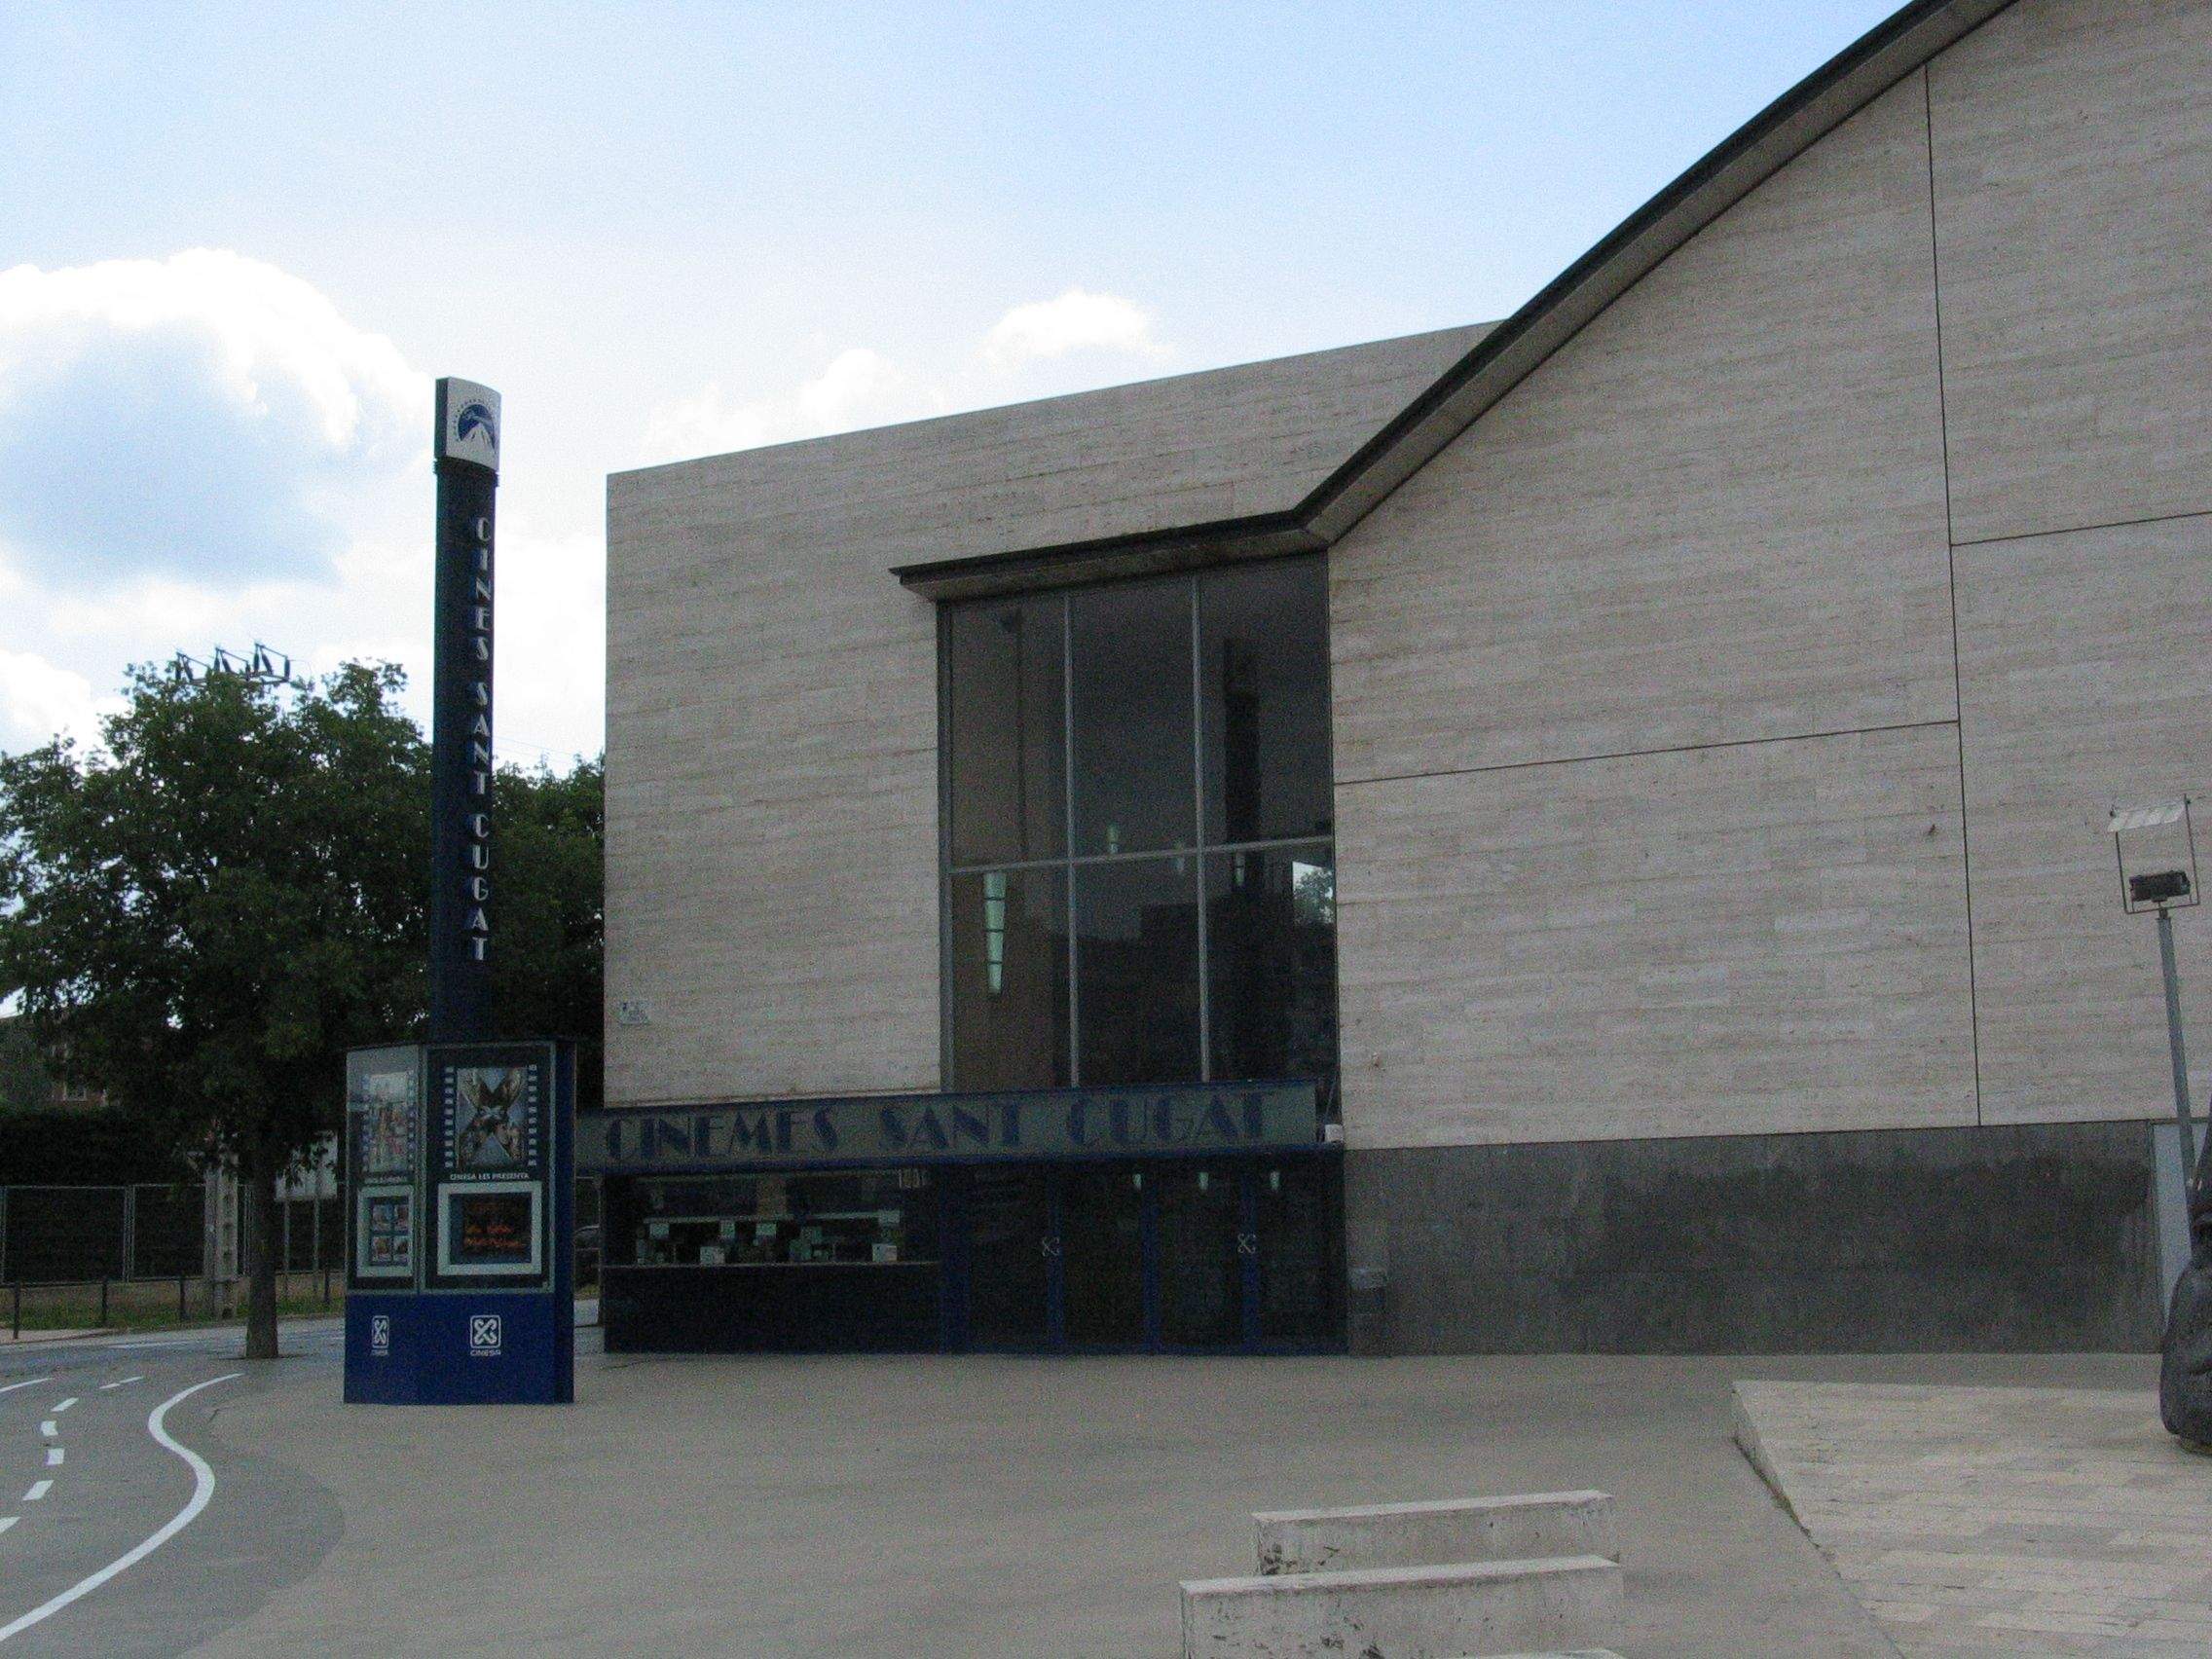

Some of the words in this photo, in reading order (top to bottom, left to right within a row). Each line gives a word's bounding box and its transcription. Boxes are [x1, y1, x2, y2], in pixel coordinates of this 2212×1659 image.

[474, 516, 492, 662] CINES
[472, 682, 491, 795] SANT
[471, 812, 491, 961] CUGAT
[605, 1104, 839, 1161] CINEMES
[878, 1099, 1029, 1151] SANT
[1065, 1092, 1275, 1149] CUGAT
